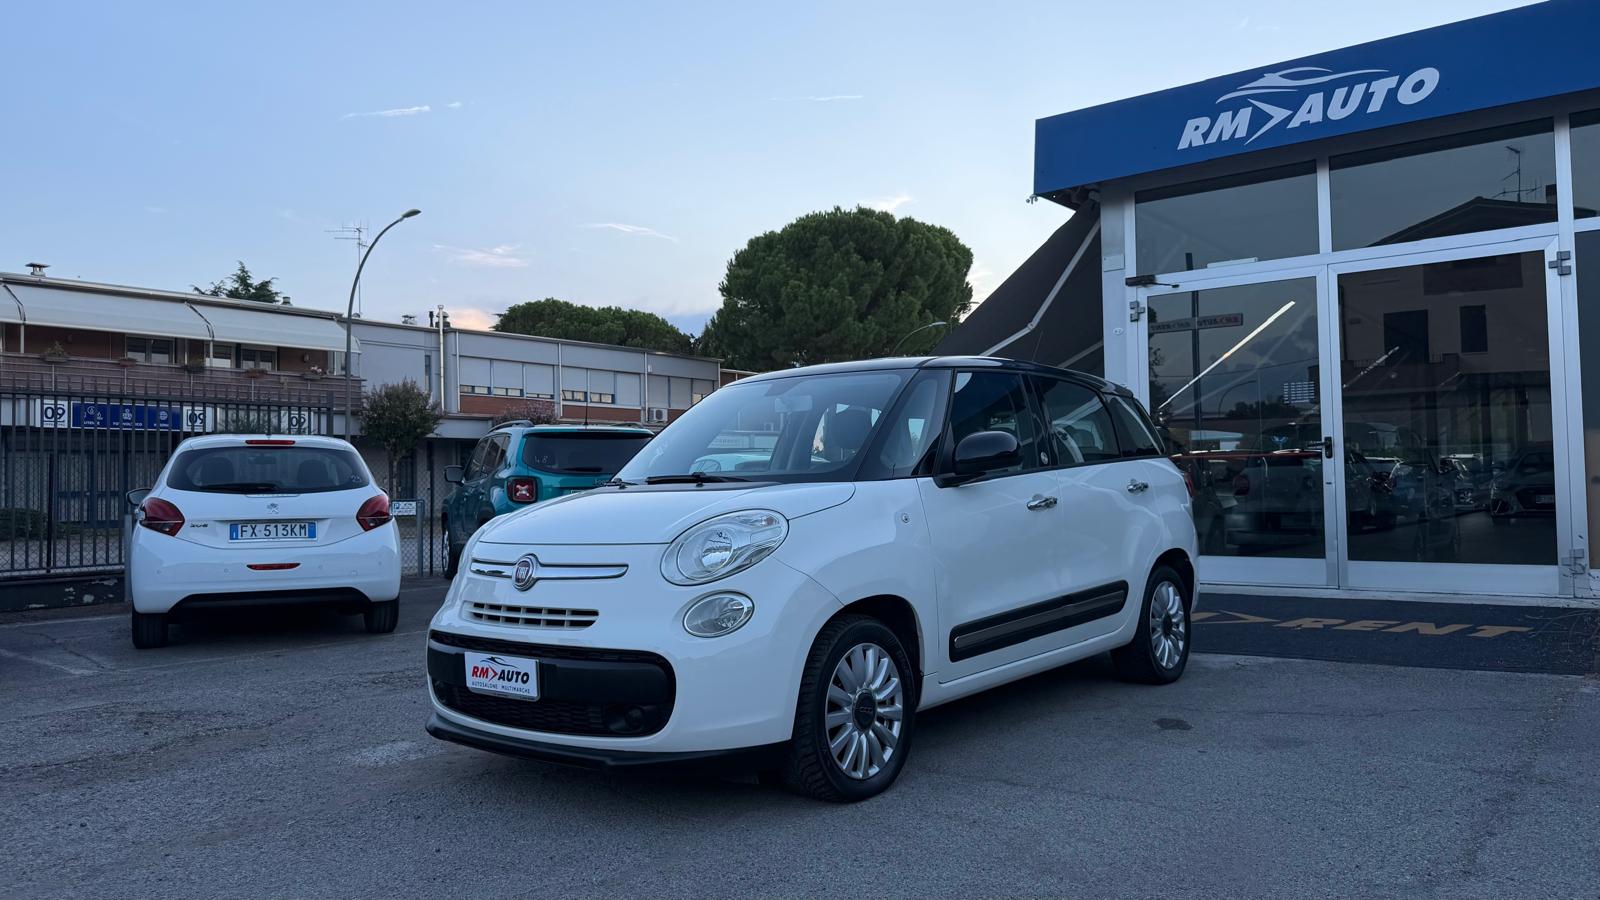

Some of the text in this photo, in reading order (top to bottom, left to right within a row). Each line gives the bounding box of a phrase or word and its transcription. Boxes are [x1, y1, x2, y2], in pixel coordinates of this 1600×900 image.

[1177, 67, 1440, 150] RM AUTO
[44, 406, 66, 420] 09
[240, 524, 258, 537] FX
[264, 523, 307, 536] 513KM
[1273, 617, 1536, 638] RENT
[471, 665, 530, 685] RM AUTO
[471, 681, 530, 694] AUTOSALONE MULTIMARCHE
